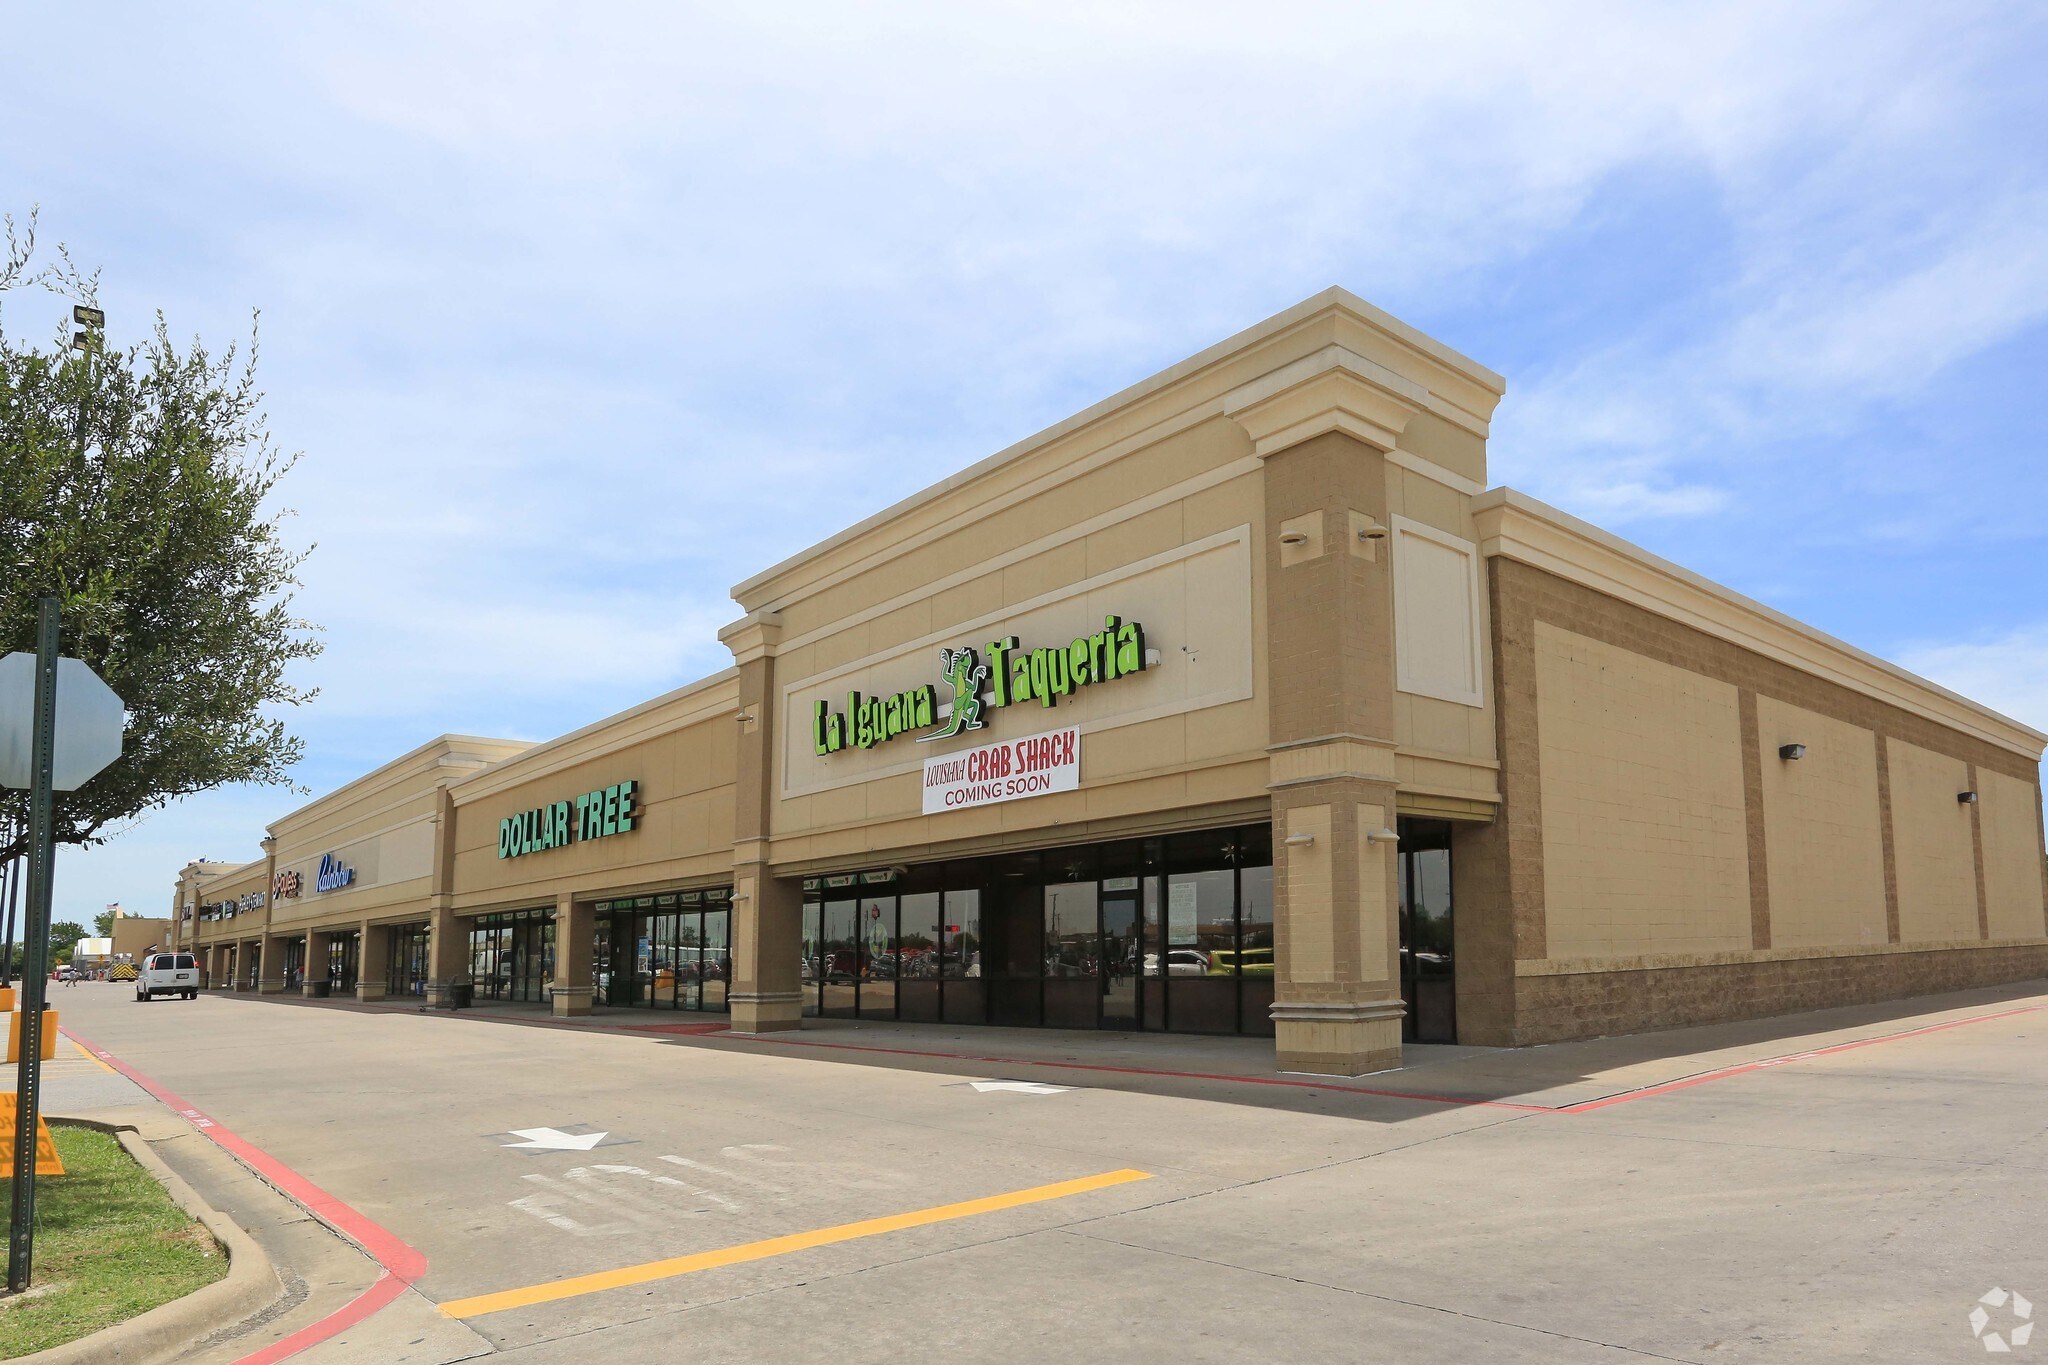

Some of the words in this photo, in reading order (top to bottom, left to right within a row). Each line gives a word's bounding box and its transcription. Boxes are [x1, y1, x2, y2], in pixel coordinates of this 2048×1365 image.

[814, 700, 846, 755] La
[848, 684, 938, 749] Iguana
[985, 615, 1146, 708] Taqueria
[926, 758, 966, 787] LOUISIANA
[967, 745, 1012, 783] CRAB
[1015, 730, 1075, 775] SHACK
[945, 782, 1002, 806] COMING
[1006, 773, 1050, 795] SOON
[499, 800, 572, 859] DOLLAR
[576, 780, 638, 842] TREE
[315, 853, 353, 893] Rainbow
